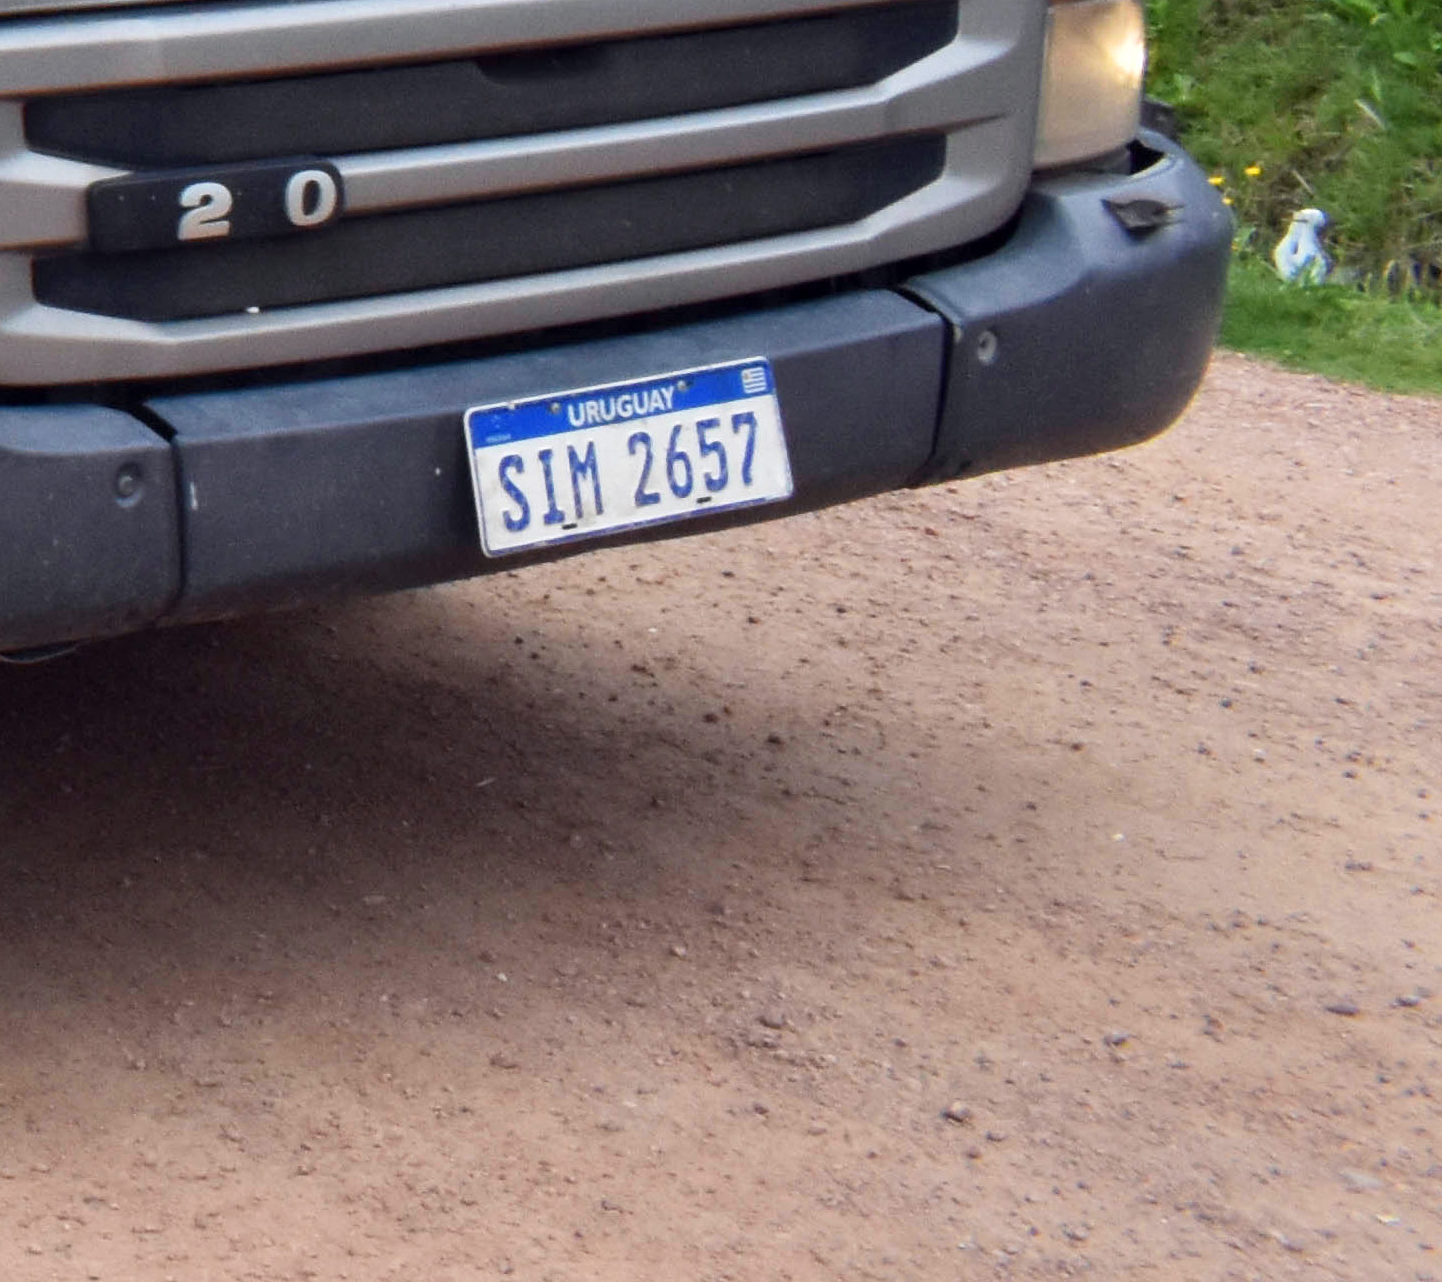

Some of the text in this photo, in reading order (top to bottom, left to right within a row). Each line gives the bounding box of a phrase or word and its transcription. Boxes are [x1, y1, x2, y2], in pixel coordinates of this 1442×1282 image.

[567, 386, 676, 427] URUGUAY
[497, 410, 759, 533] SIM 2657
